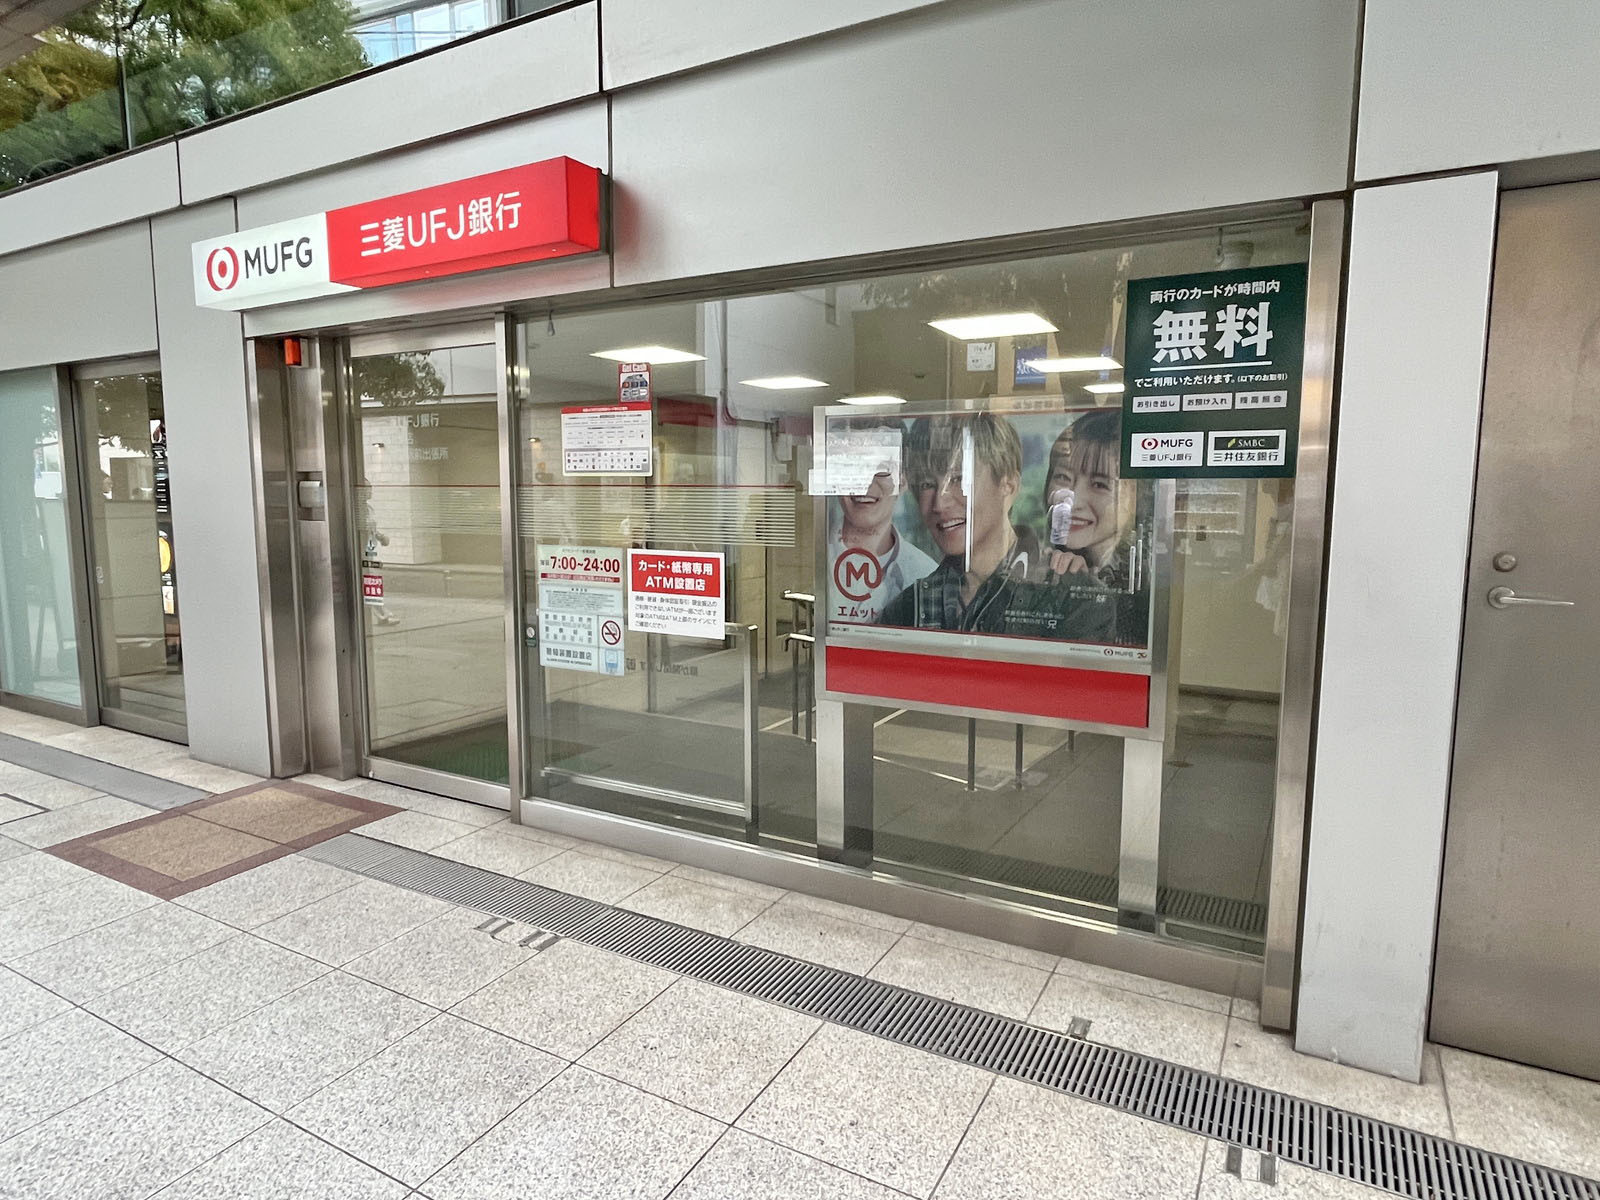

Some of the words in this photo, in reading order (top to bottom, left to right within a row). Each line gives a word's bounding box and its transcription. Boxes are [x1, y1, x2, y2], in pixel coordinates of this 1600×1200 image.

[359, 190, 522, 257] 三菱UFJ銀行
[244, 236, 314, 279] MUFG
[1150, 279, 1281, 304] 両行のカードが時間内
[1152, 301, 1274, 363] 無料
[1134, 373, 1236, 389] でご利用いただけます。
[1136, 399, 1176, 409] お引き出し
[1186, 397, 1228, 407] お預け入れ
[1160, 438, 1194, 449] MUFG
[1237, 438, 1266, 448] SMBC
[1141, 453, 1193, 462] 三菱UFJ銀行
[1213, 451, 1279, 462] 三井住友銀行
[638, 559, 714, 576] カード・紙幣専用
[645, 576, 706, 592] ATM設置店
[837, 606, 879, 618] エムット
